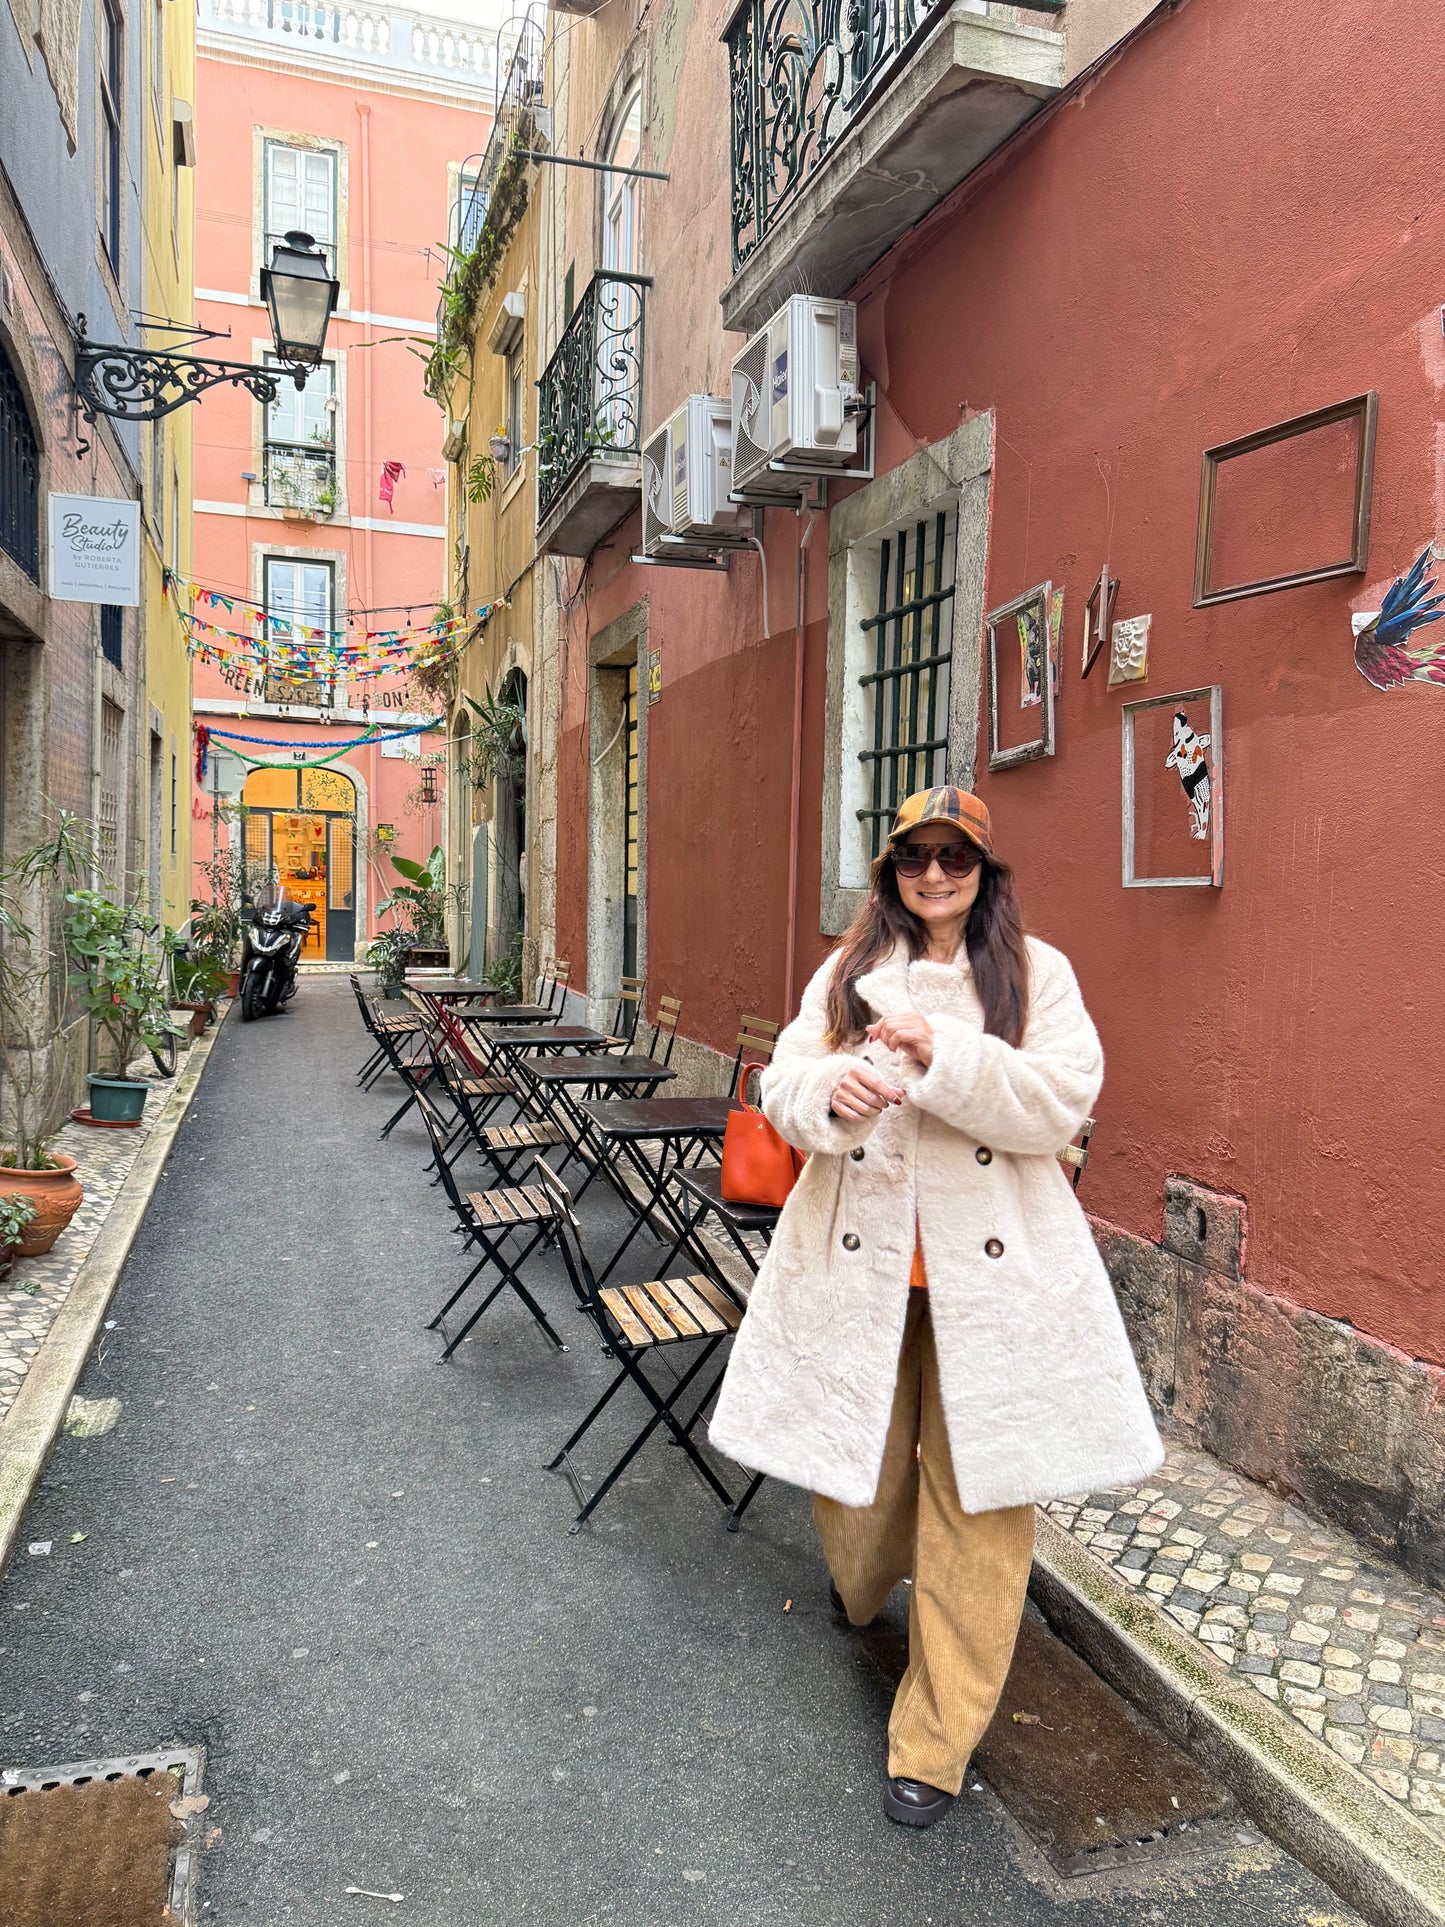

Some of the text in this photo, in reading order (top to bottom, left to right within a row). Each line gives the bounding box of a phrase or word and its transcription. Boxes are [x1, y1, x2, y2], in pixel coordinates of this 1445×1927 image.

[62, 513, 129, 549] Beauty
[70, 535, 114, 552] Studio
[72, 553, 122, 563] by ROBERTA
[74, 562, 119, 571] GUTIERRES
[347, 691, 403, 708] LISON
